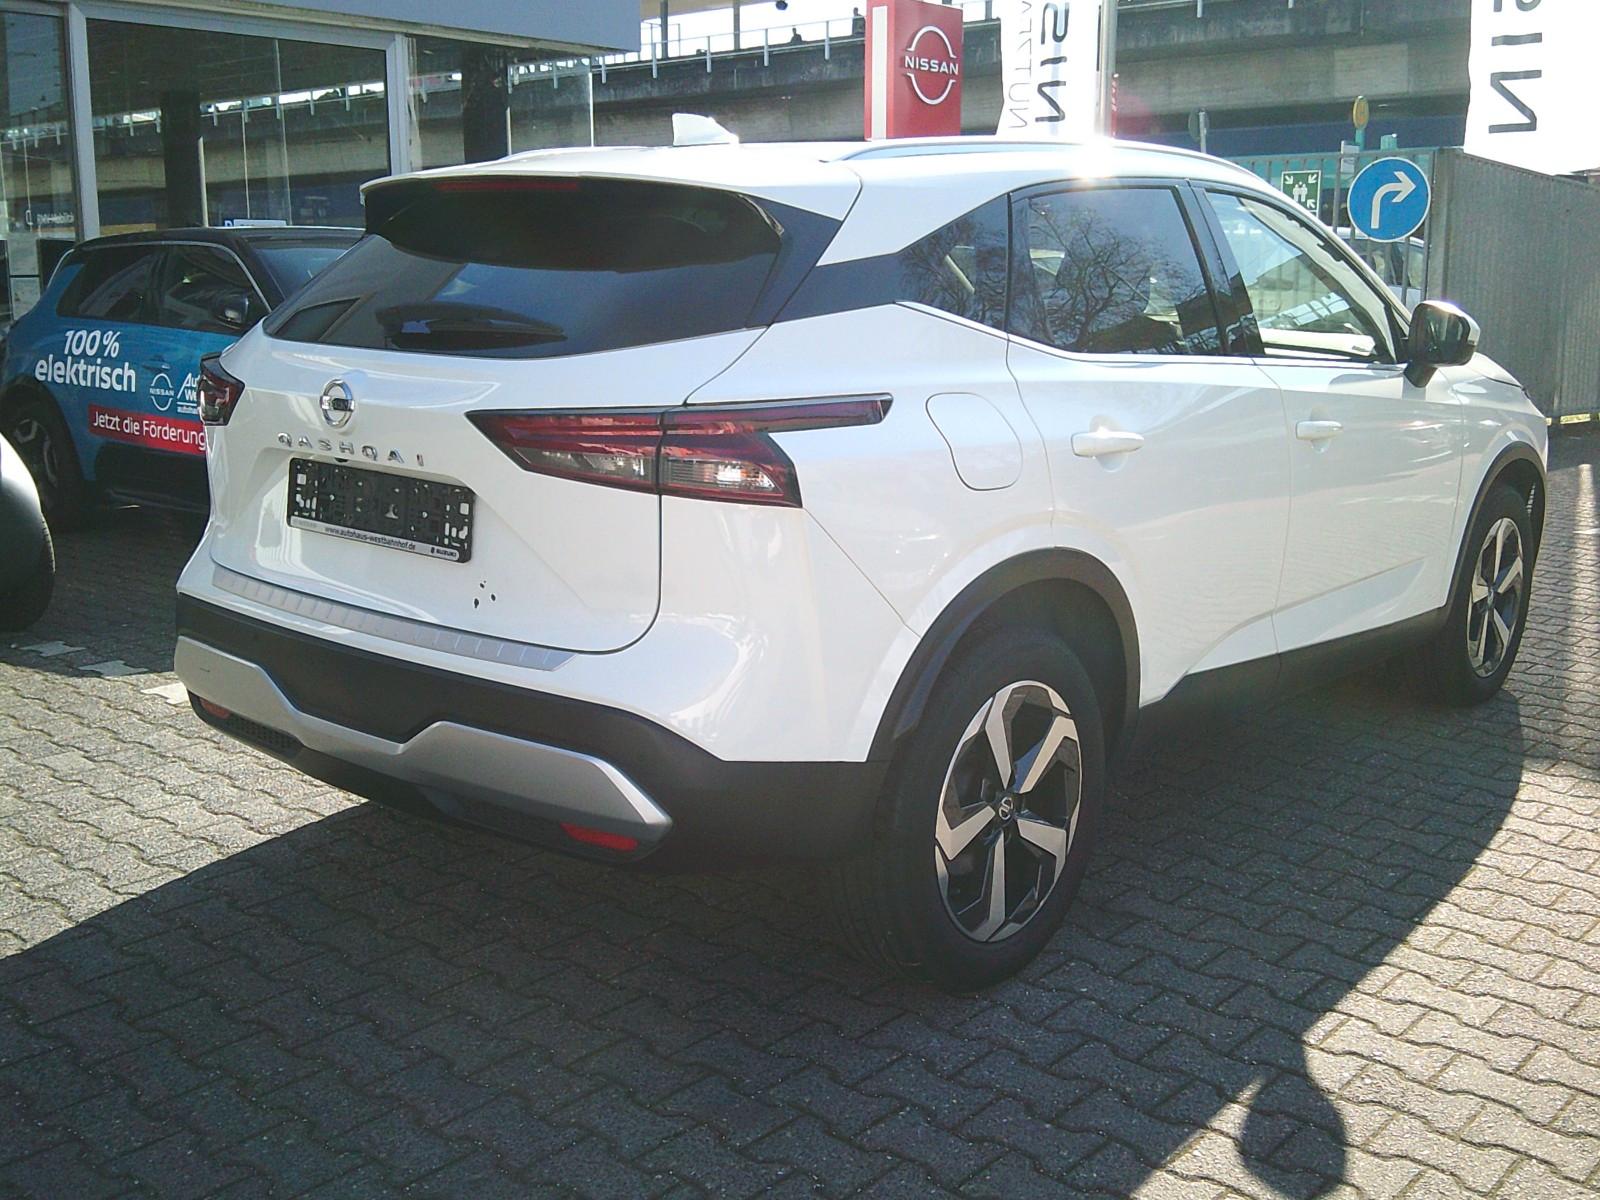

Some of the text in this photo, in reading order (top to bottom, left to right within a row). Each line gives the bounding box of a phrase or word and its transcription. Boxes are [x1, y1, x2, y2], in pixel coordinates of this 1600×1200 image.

[904, 55, 960, 76] NISSAN
[64, 330, 121, 358] 100%
[35, 354, 136, 392] elektrisch
[149, 387, 175, 397] NISSAN
[93, 411, 207, 451] Jetzt die Förderung
[278, 432, 424, 466] QASHQAI
